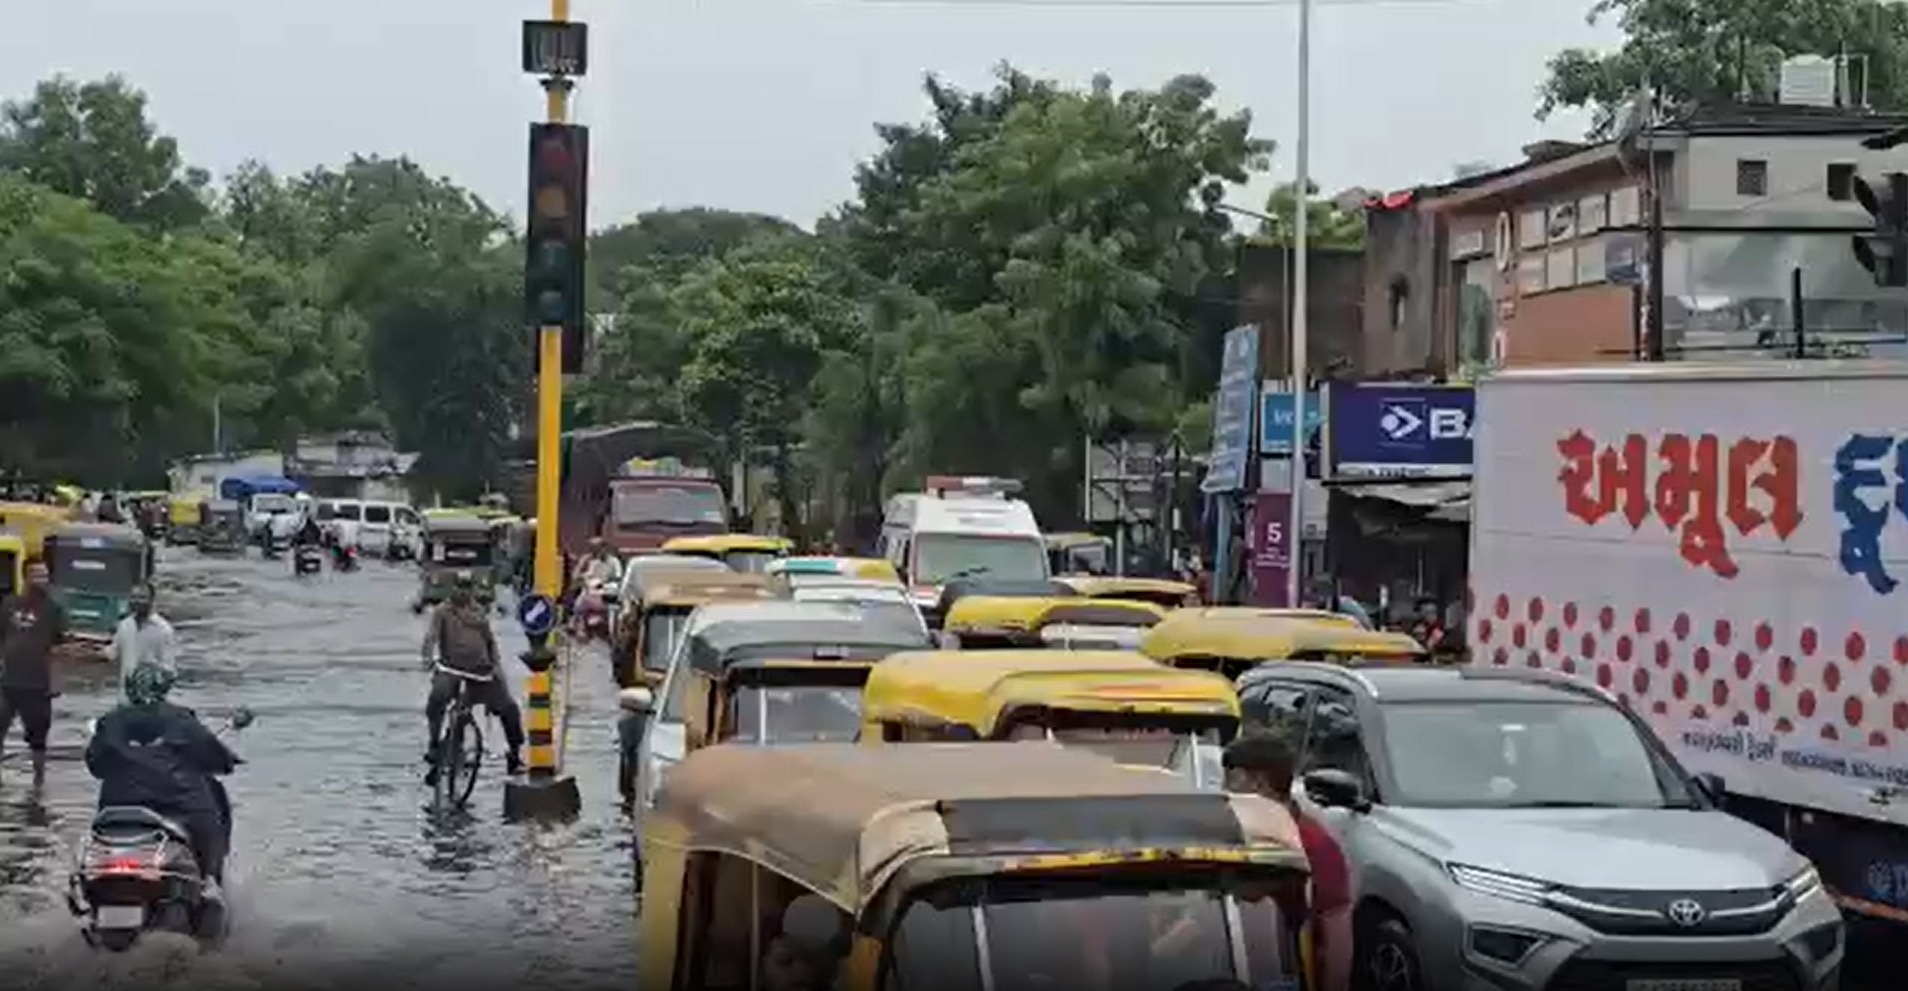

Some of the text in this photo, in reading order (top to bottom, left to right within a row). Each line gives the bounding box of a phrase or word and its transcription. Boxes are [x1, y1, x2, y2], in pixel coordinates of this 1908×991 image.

[1430, 408, 1474, 440] B
[1557, 428, 1908, 595] અમૂલ દૂ
[1268, 522, 1282, 543] 5
